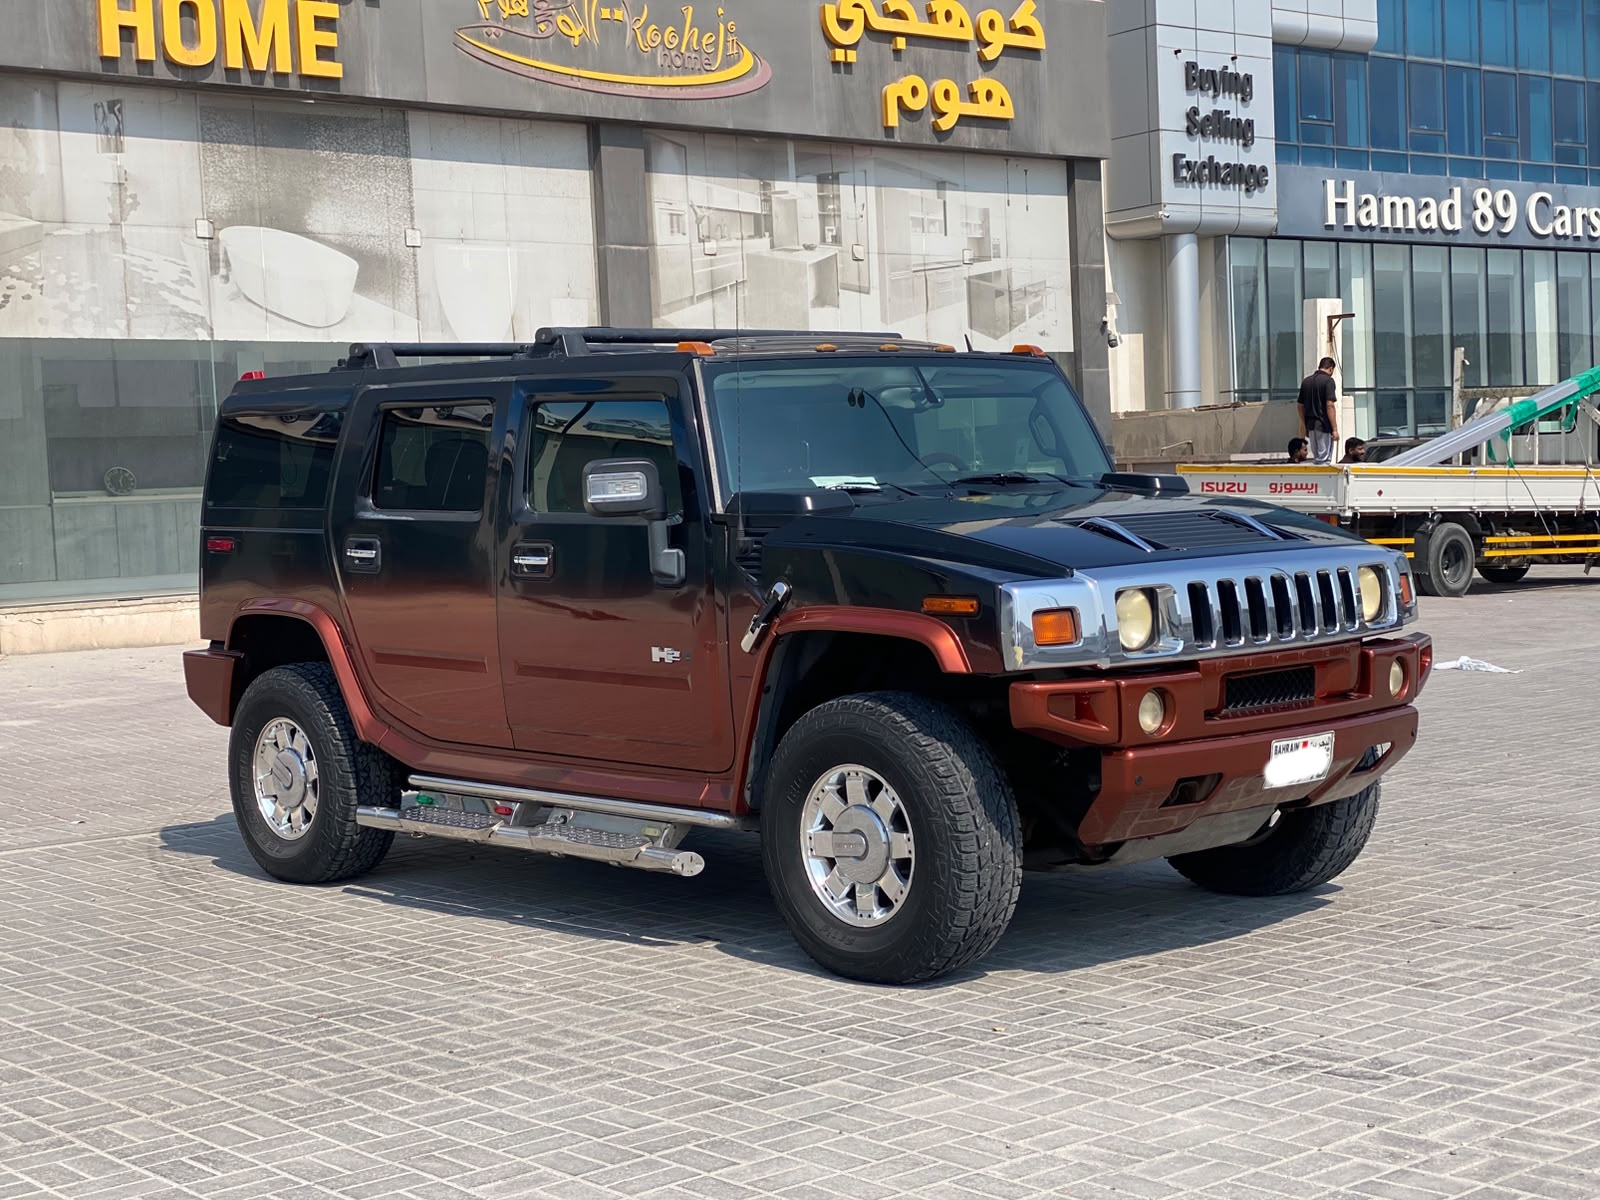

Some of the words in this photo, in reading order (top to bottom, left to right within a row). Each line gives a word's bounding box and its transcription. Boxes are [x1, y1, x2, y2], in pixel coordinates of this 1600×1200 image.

[98, 0, 343, 78] HOME
[1185, 61, 1253, 102] Buying
[882, 74, 1015, 132] هوم
[1186, 106, 1255, 147] Selling
[1173, 153, 1269, 193] Exchange
[1323, 179, 1462, 231] Hamad
[1472, 187, 1517, 234] 89
[1526, 191, 1600, 239] Cars
[1201, 481, 1248, 493] ISUZU
[651, 646, 681, 663] H2
[1273, 742, 1300, 756] BAHRAIN
